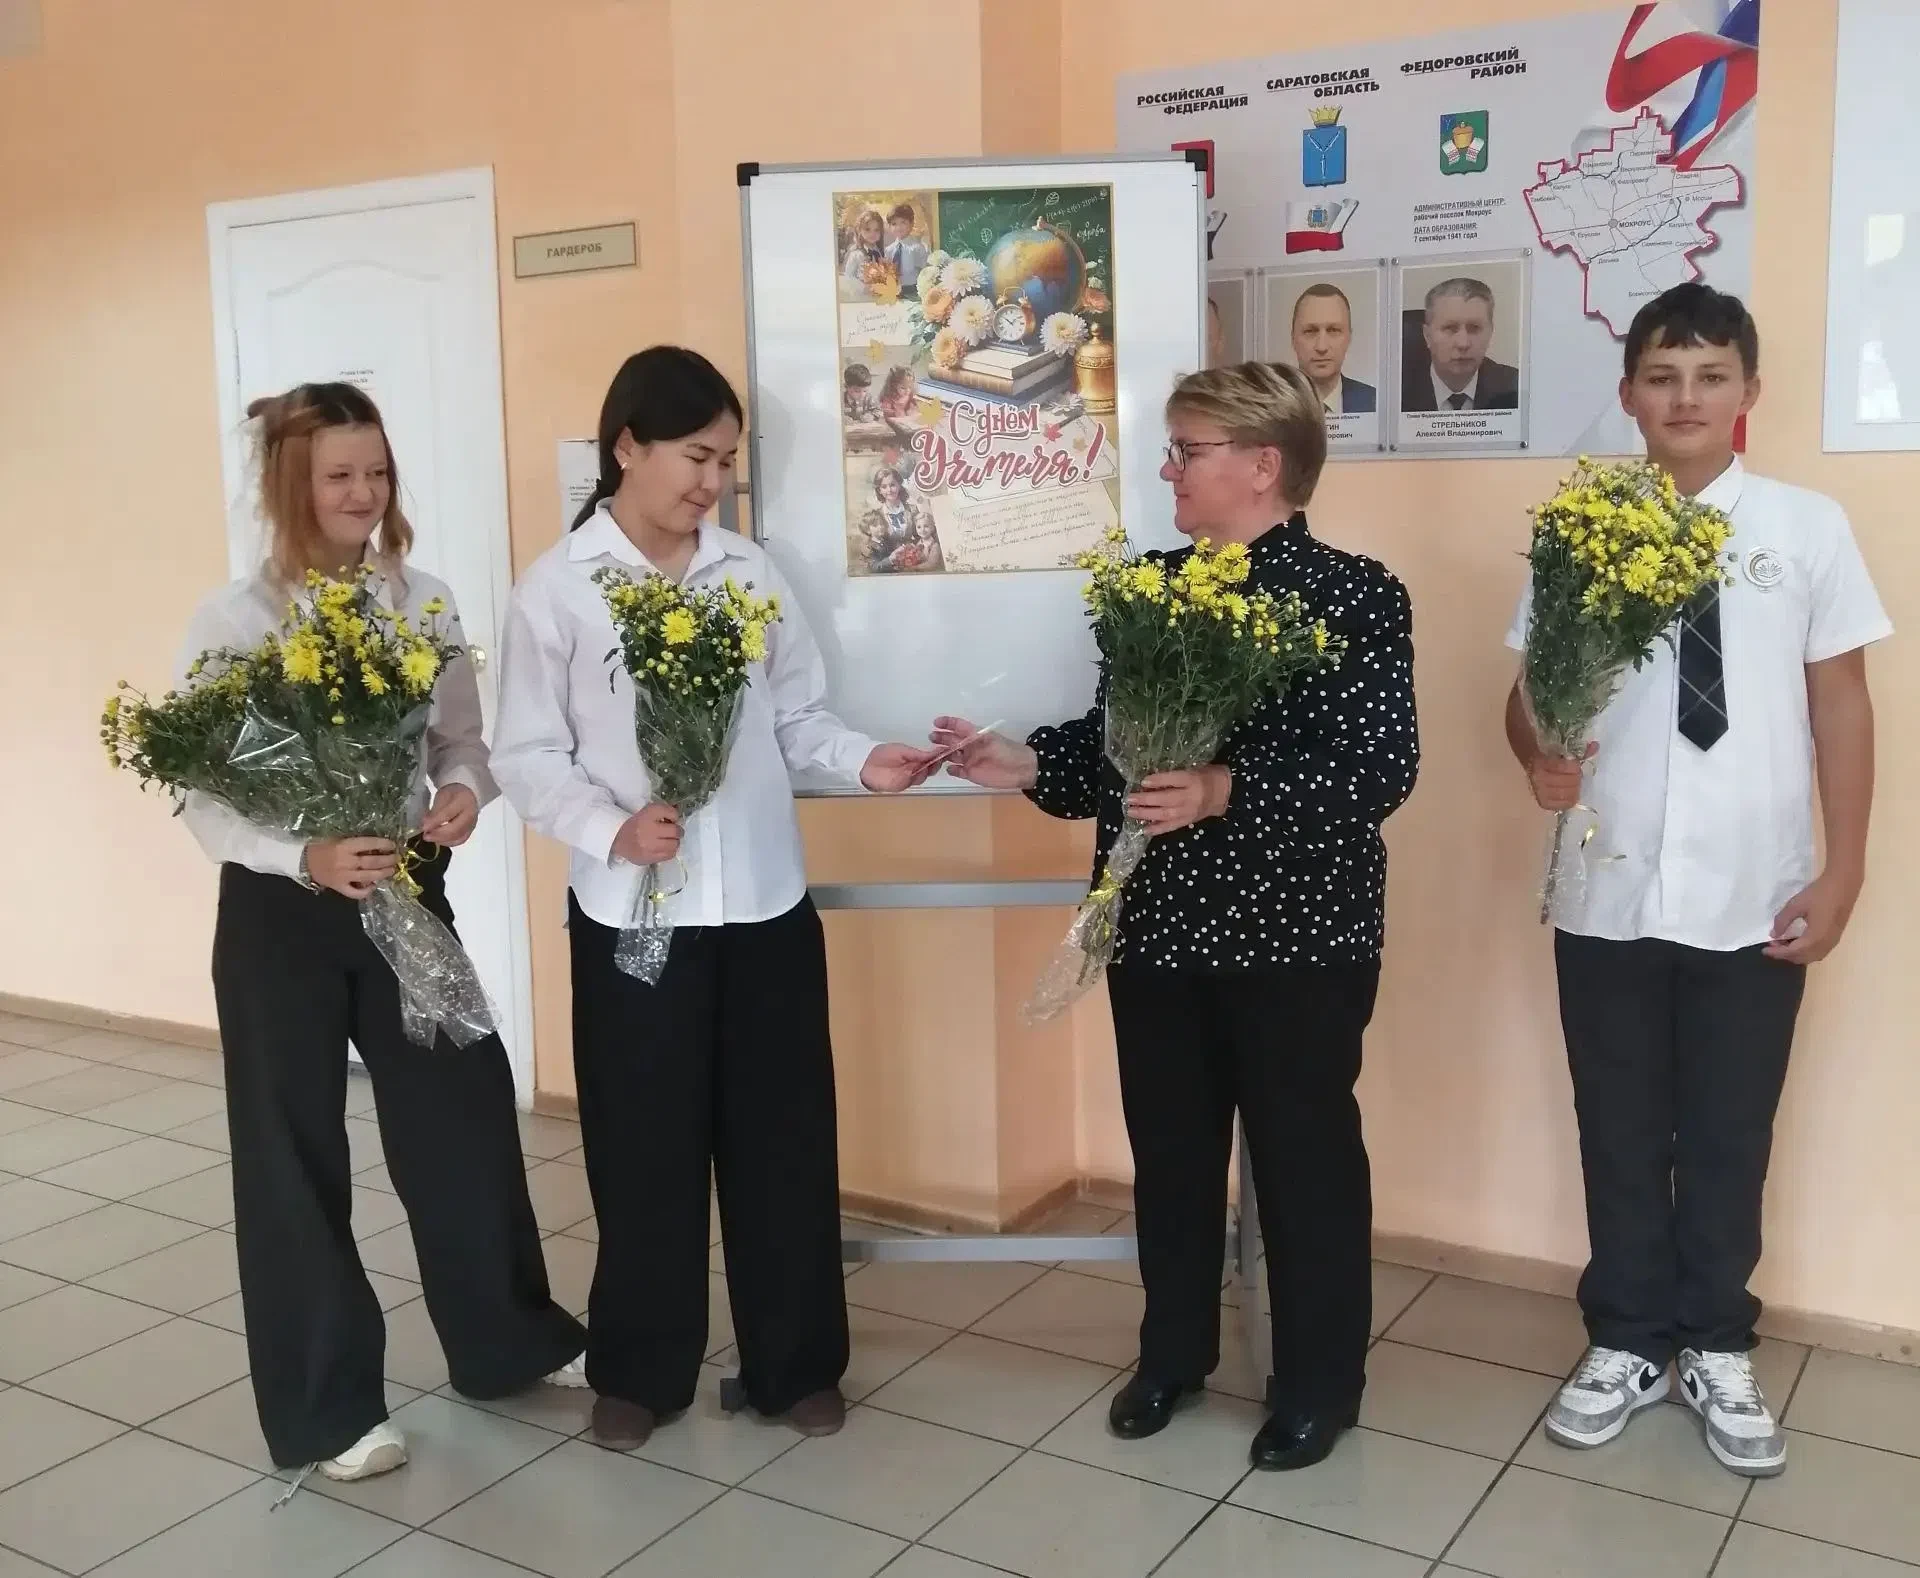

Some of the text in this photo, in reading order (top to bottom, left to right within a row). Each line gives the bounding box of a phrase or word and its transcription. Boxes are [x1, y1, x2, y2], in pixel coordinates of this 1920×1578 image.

[1400, 46, 1519, 74] ФЕДОРОВСКИЙ
[1266, 68, 1370, 90] САРАТОВСКАЯ
[1471, 63, 1527, 79] РАЙОН
[1137, 86, 1224, 105] РОССИЙСКАЯ
[1313, 81, 1380, 98] ОБЛАСТЬ
[1164, 96, 1248, 114] ФЕДЕРАЦИЯ
[1414, 226, 1430, 235] ДАТА
[1447, 232, 1462, 240] 1941
[546, 242, 603, 258] ГАРДЕРОБ
[950, 401, 1040, 457] С днём
[1431, 420, 1487, 429] СТРЕЛЬНИКОВ
[1447, 428, 1503, 437] Владимирович
